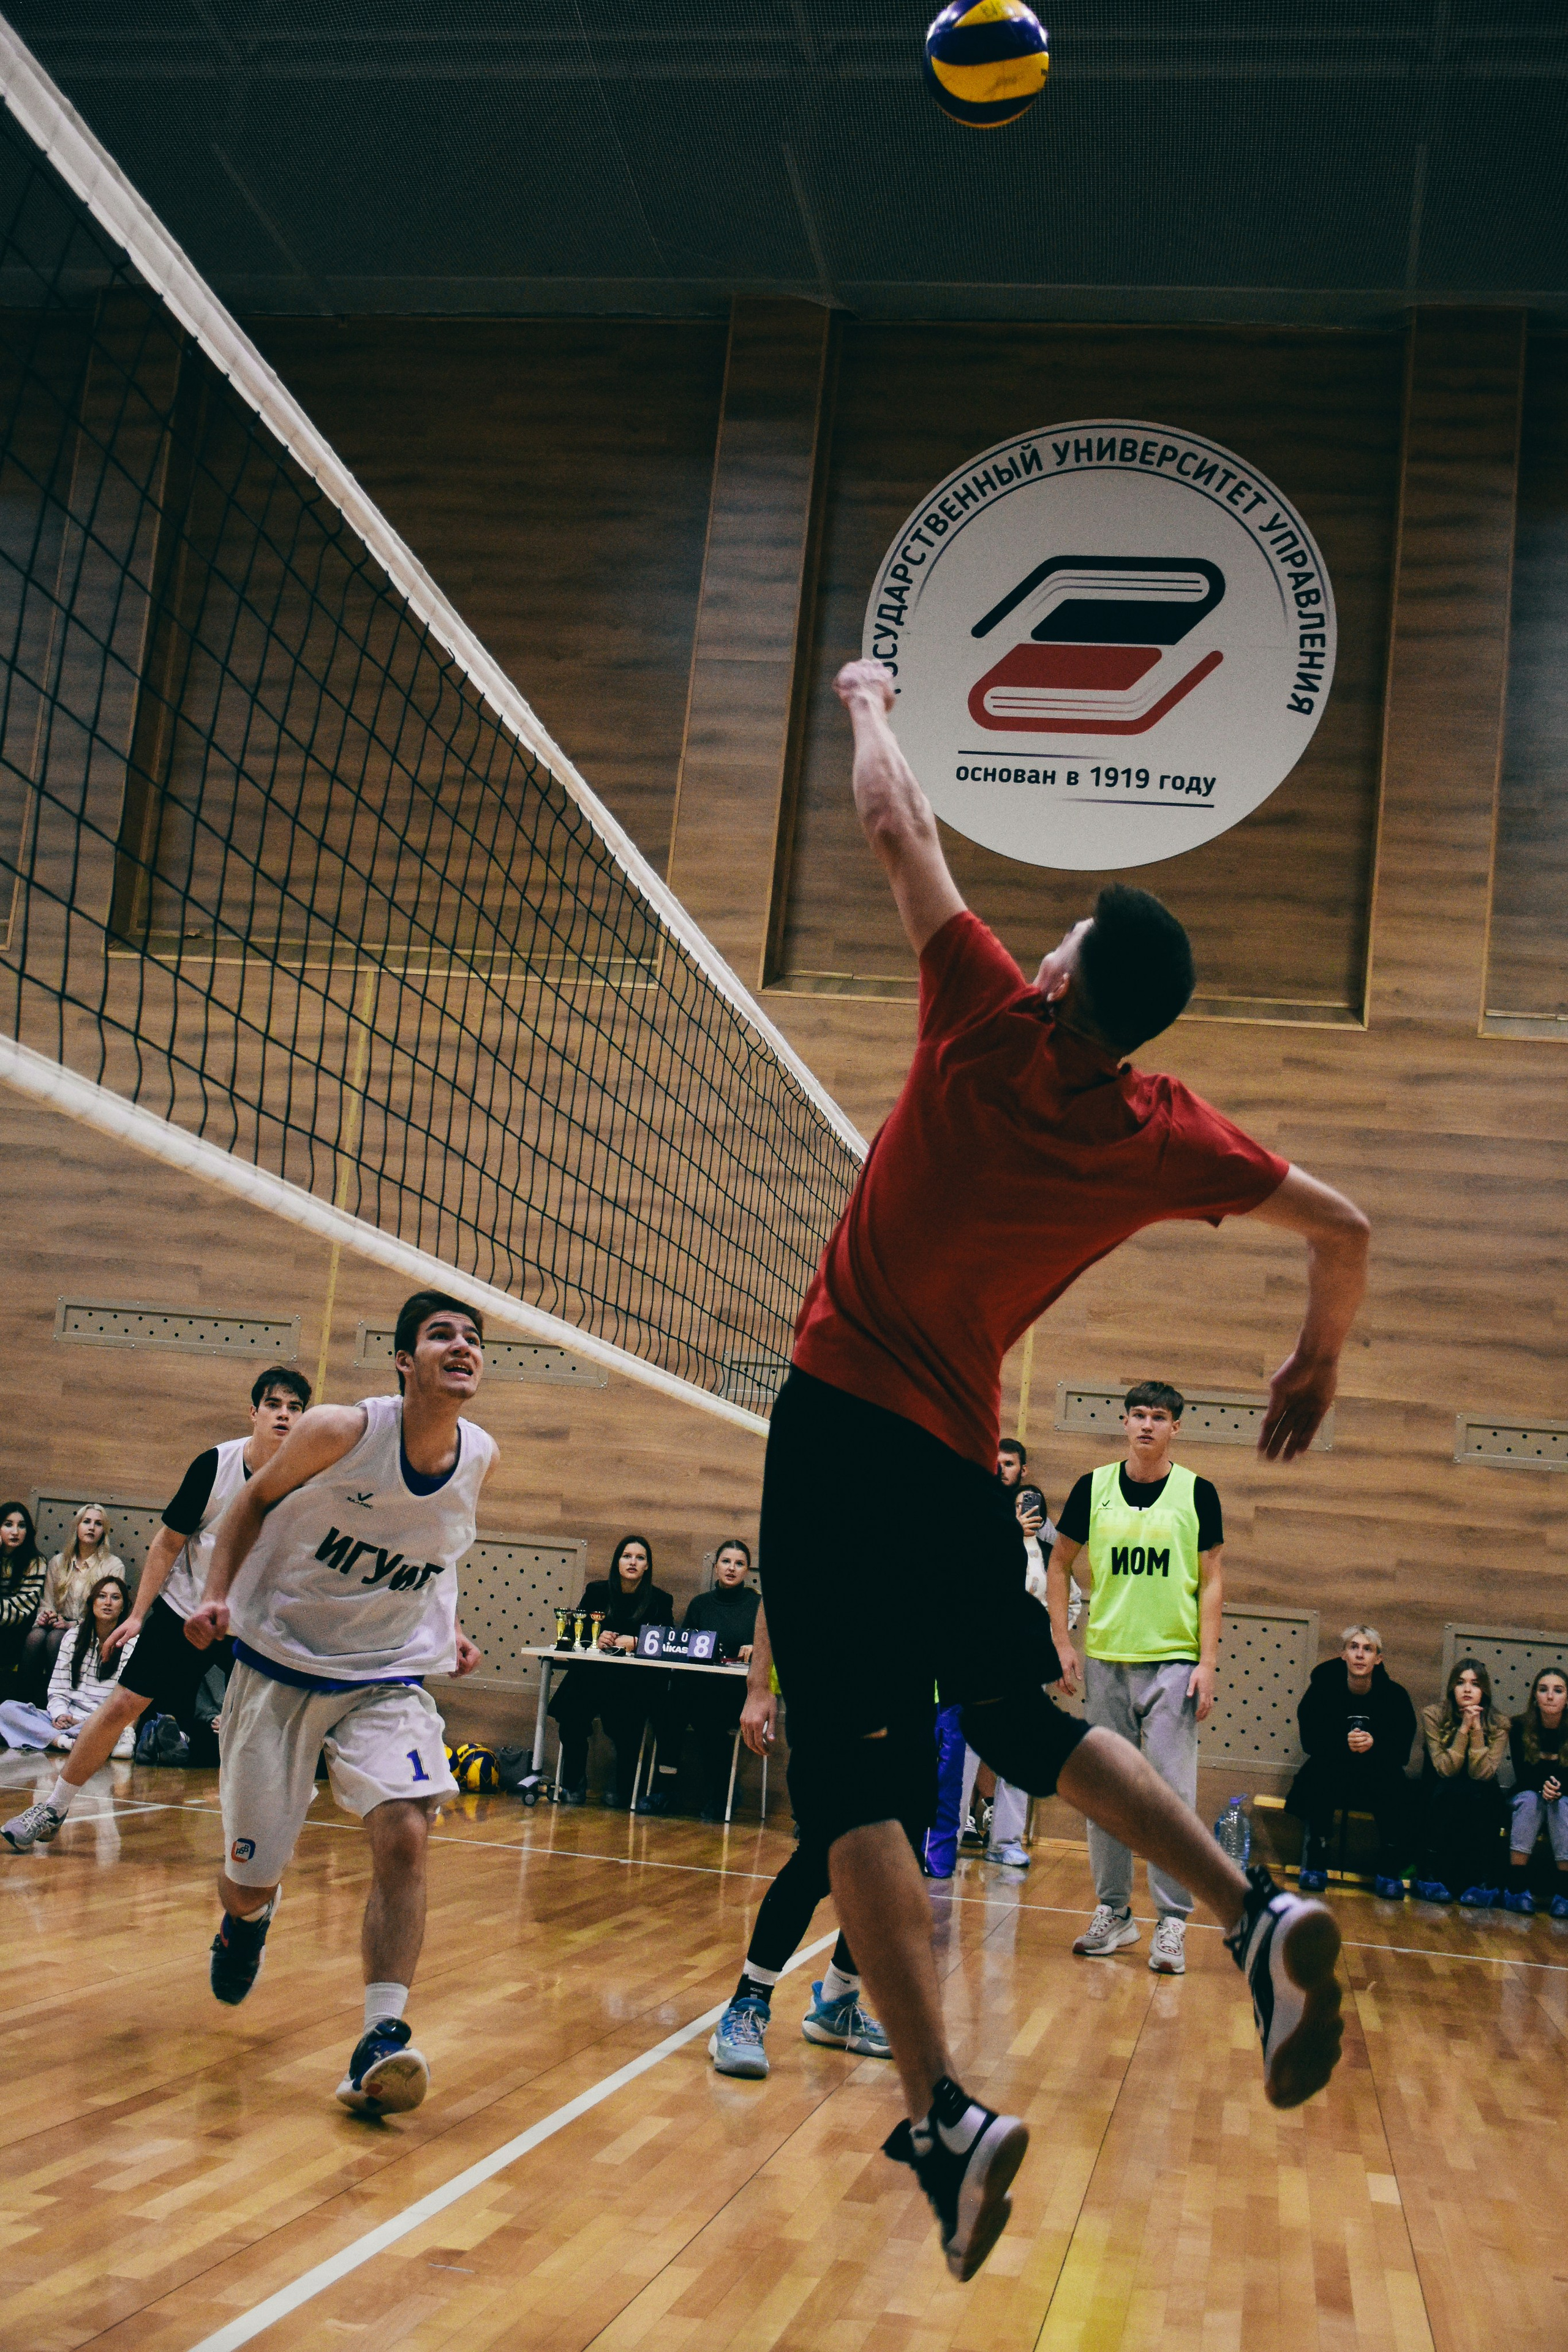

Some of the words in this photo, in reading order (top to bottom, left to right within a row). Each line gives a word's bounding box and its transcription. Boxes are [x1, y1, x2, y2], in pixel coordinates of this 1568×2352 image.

[872, 443, 1043, 695] СУДАРСТВЕННЫЙ
[1052, 437, 1268, 514] УНИВЕРСИТЕТ
[1258, 512, 1326, 715] УПРАВЛЕНИЯ
[956, 765, 1056, 785] основан
[1066, 770, 1079, 786] в
[1090, 766, 1150, 789] 1919
[1159, 774, 1217, 797] году
[1111, 1546, 1170, 1577] ИОМ
[644, 1630, 660, 1654] 6
[668, 1630, 676, 1642] 0
[681, 1632, 688, 1642] 0
[693, 1635, 710, 1657] 8
[405, 1748, 431, 1782] 1
